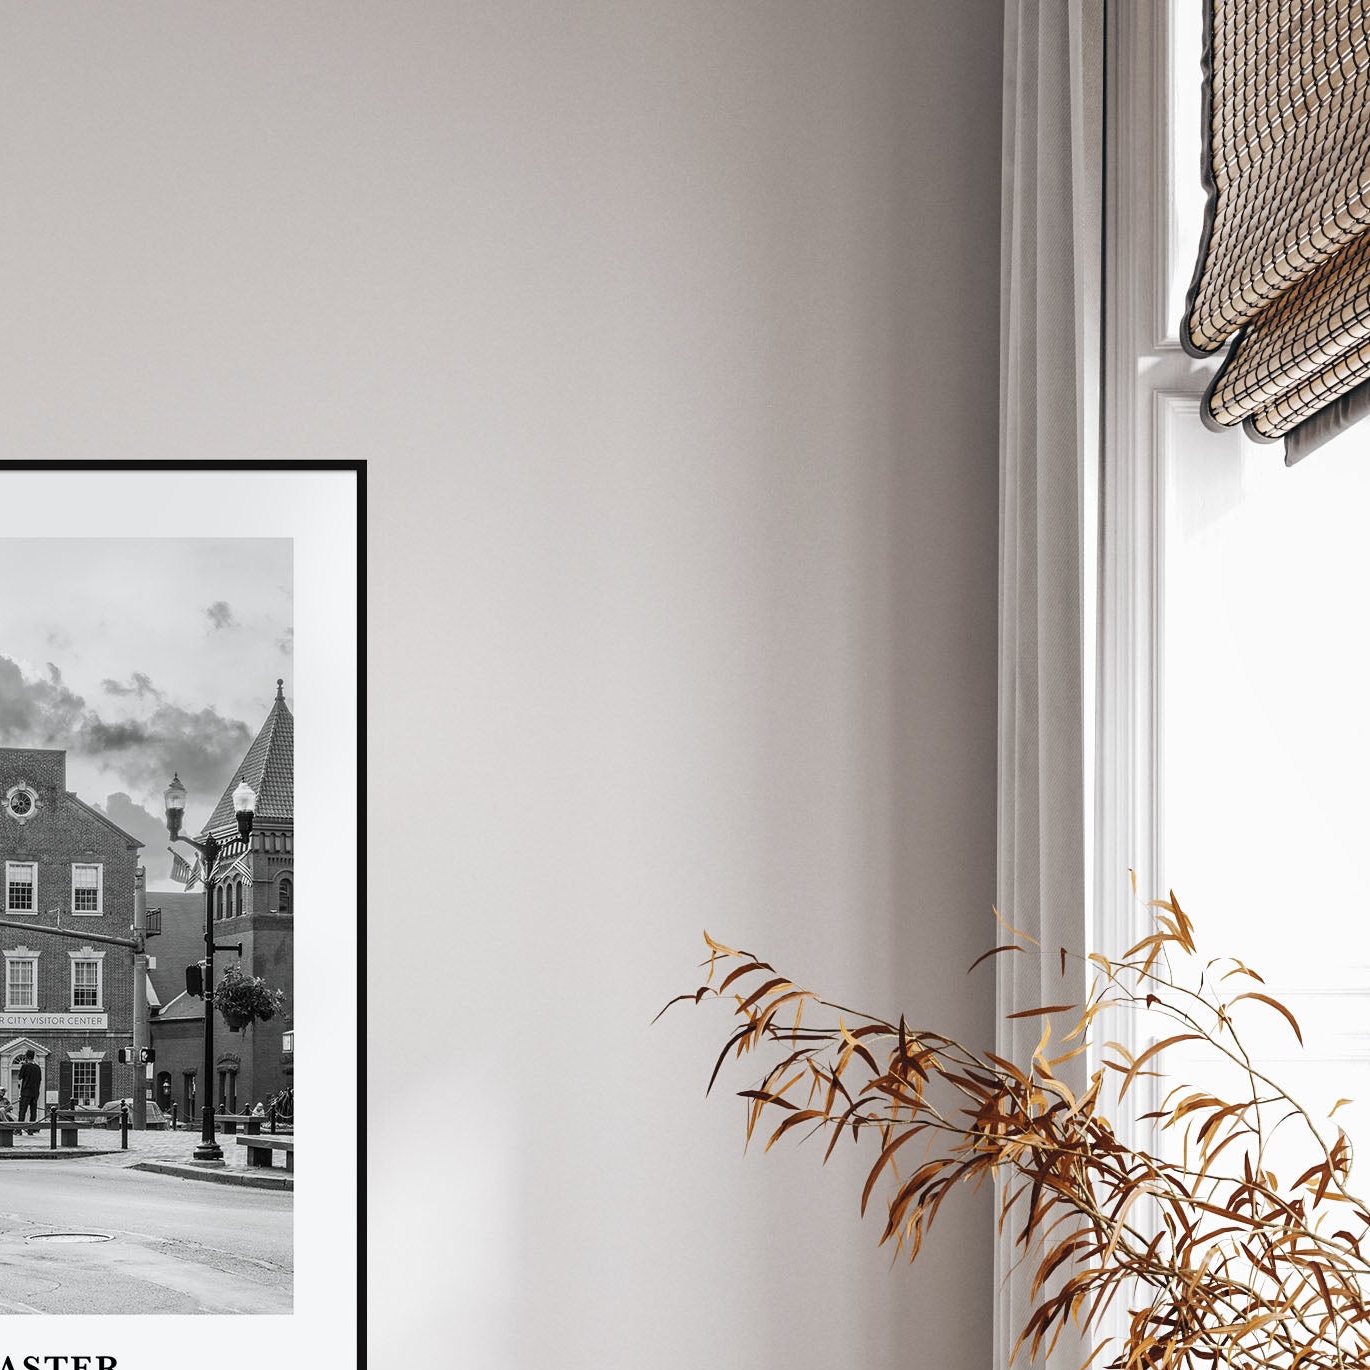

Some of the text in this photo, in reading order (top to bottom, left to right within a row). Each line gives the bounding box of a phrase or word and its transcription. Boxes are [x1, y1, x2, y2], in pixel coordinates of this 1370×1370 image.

[7, 1016, 28, 1026] CITY
[30, 1016, 65, 1026] VISITOR
[67, 1016, 103, 1026] CENTER
